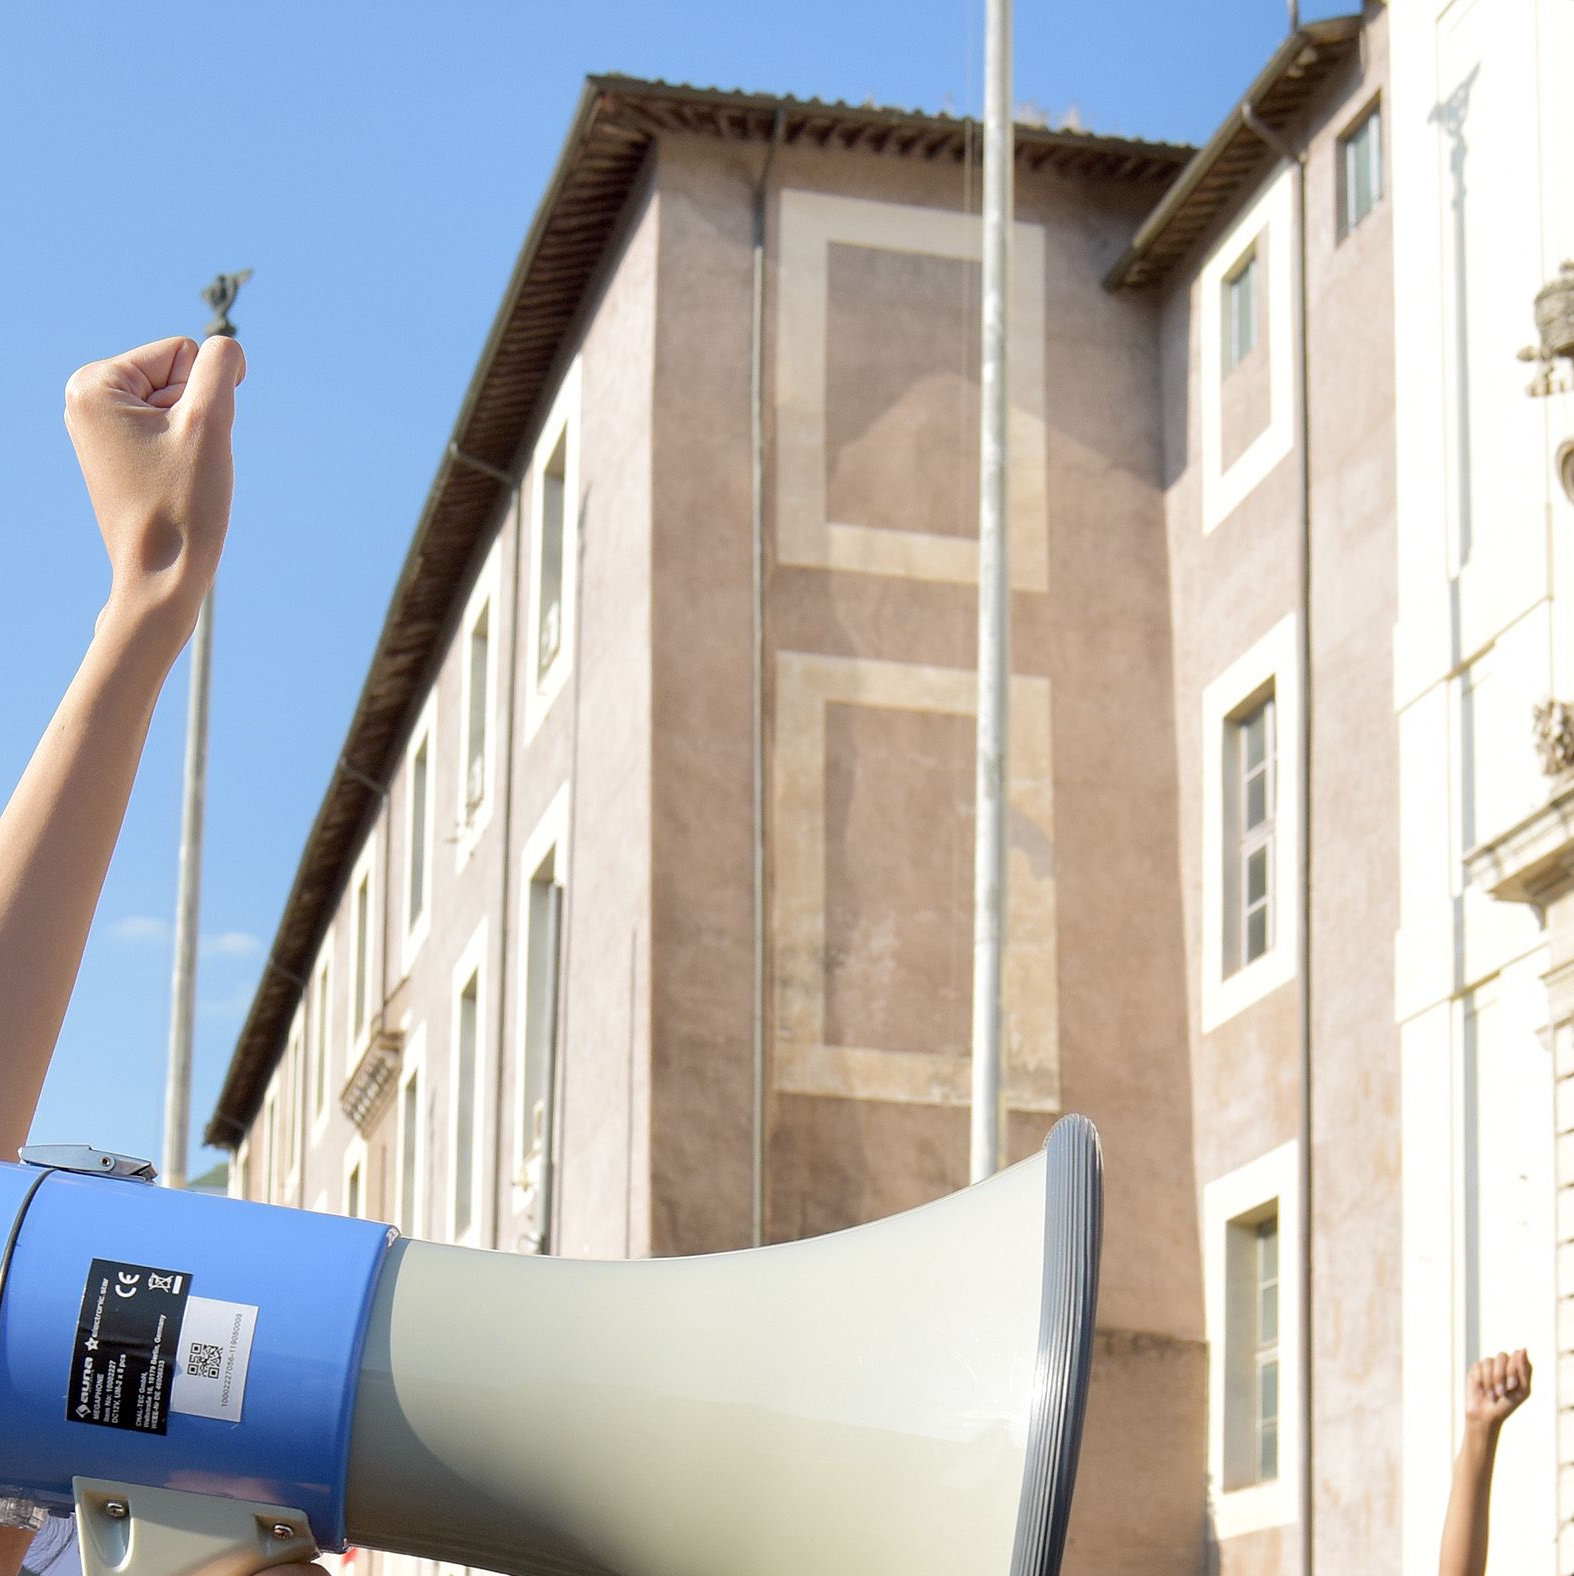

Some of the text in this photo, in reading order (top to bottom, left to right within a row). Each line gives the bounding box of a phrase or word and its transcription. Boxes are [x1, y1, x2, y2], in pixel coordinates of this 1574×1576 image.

[154, 1313, 167, 1343] Germany
[81, 1356, 93, 1403] auna
[119, 1353, 127, 1368] pcs
[93, 1373, 104, 1420] MEGAPHONE
